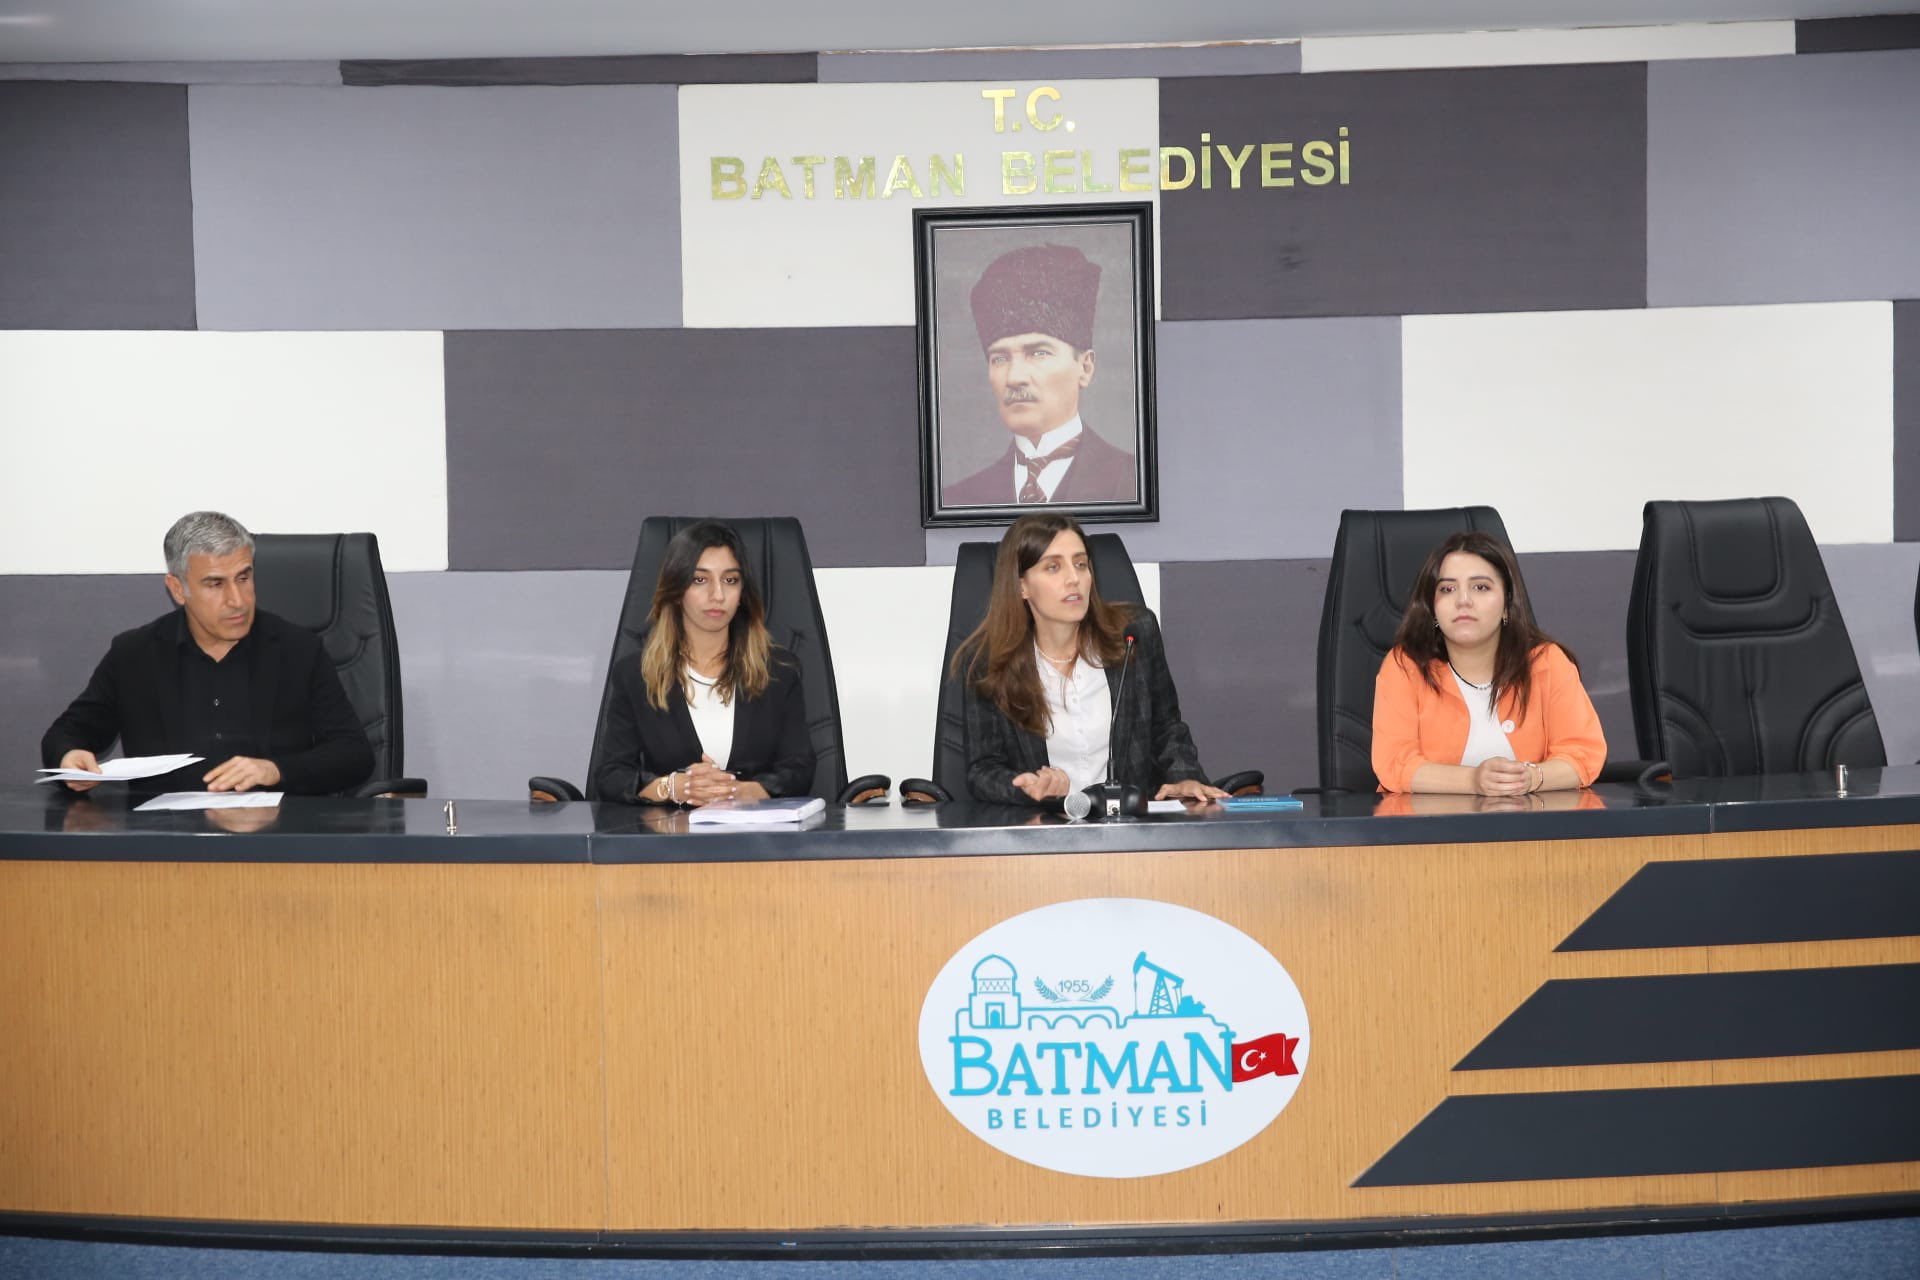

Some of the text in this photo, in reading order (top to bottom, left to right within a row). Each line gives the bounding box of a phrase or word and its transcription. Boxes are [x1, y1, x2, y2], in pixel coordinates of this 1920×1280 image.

[982, 86, 1076, 133] T.C.
[709, 126, 1351, 200] BATMAN BELEDİYESİ
[1058, 979, 1090, 993] 1955
[949, 1032, 1236, 1096] BATMAN
[987, 1100, 1207, 1129] BELEDİYESİ
